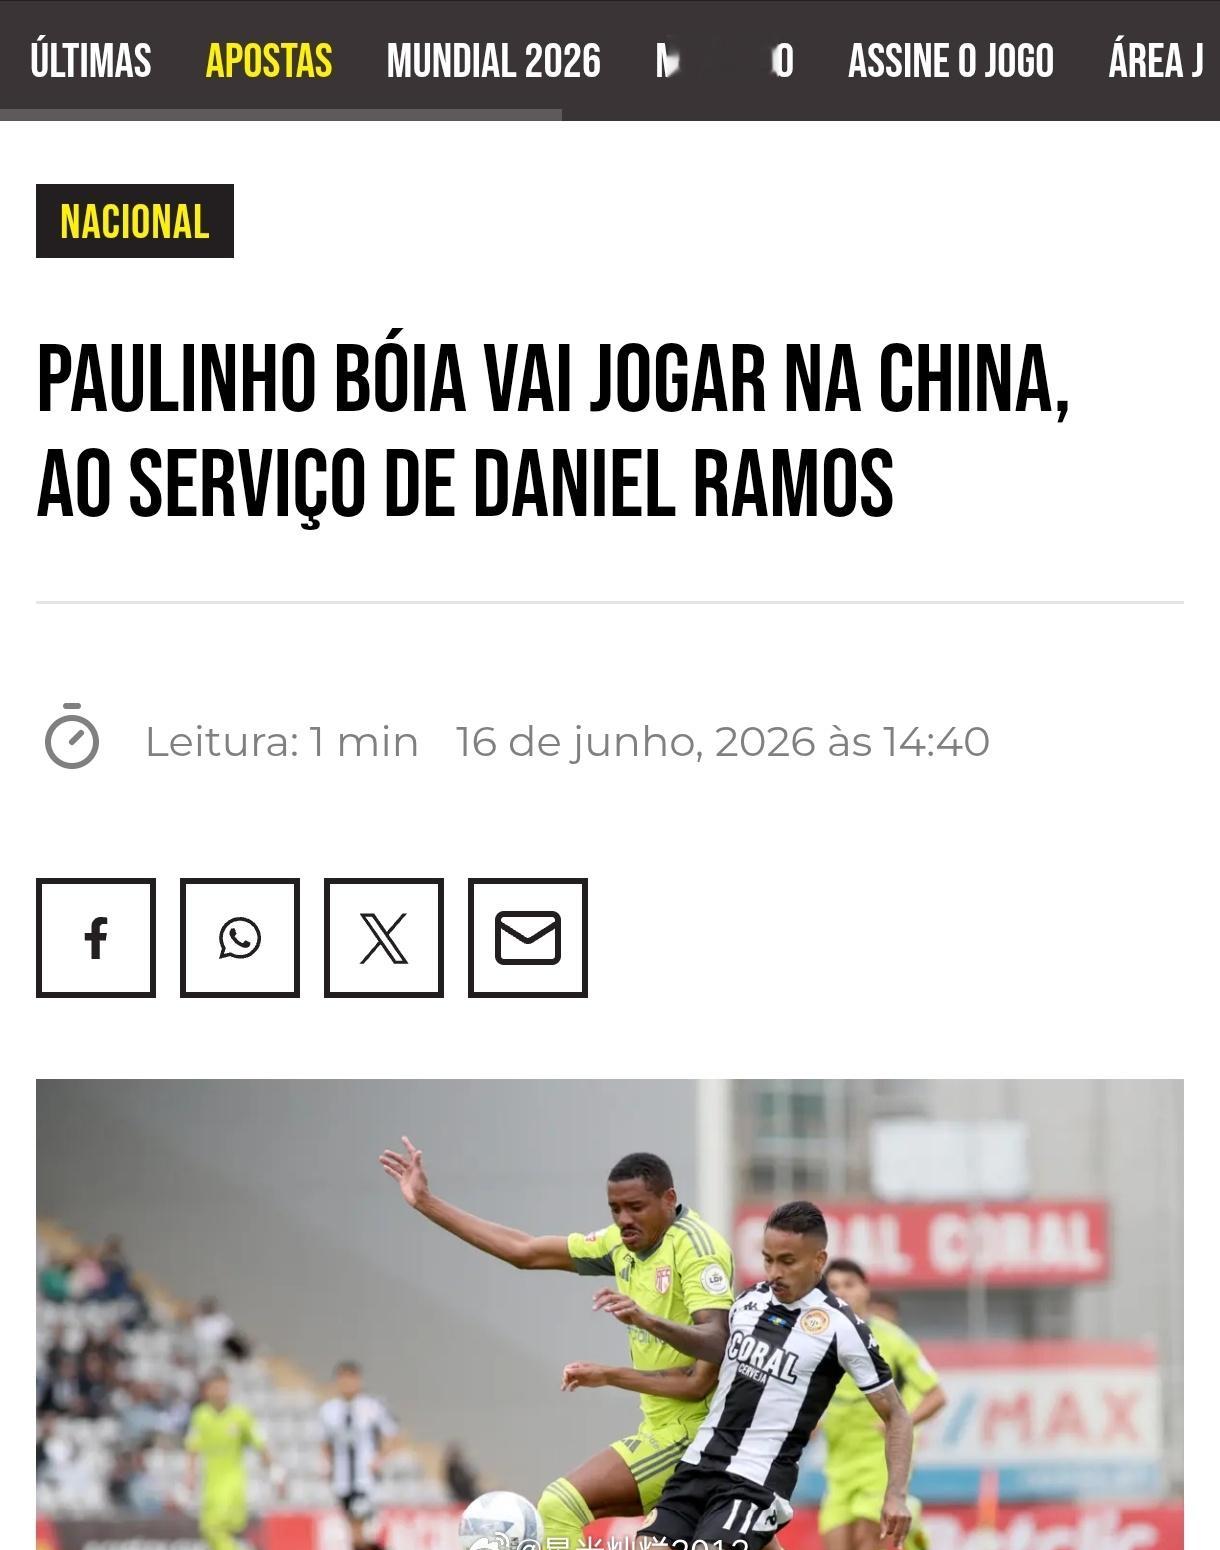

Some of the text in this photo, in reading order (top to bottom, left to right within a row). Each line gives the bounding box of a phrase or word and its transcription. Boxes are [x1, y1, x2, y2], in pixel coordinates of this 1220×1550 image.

[31, 35, 151, 77] ÚLTIMAS
[205, 43, 333, 77] APOSTAS
[388, 43, 600, 77] MUNDIAL 2026
[848, 43, 1053, 77] ASSINE O JOGO
[1109, 35, 1203, 77] ÁREA J
[62, 204, 209, 238] NACIONAL
[40, 328, 1068, 423] PAULINHO BÓIA VAI JOGAR NA CHINA,
[37, 448, 893, 530] AO SERVIÇO DE DANIEL RAMOS
[149, 725, 416, 756] Leitura: 1 min
[456, 725, 989, 764] 16 de junho, 2026 às 14:40
[930, 1209, 1102, 1273] CORAL
[728, 1330, 799, 1385] CORAL
[738, 1362, 768, 1385] CERVEJA
[722, 1499, 760, 1535] 11
